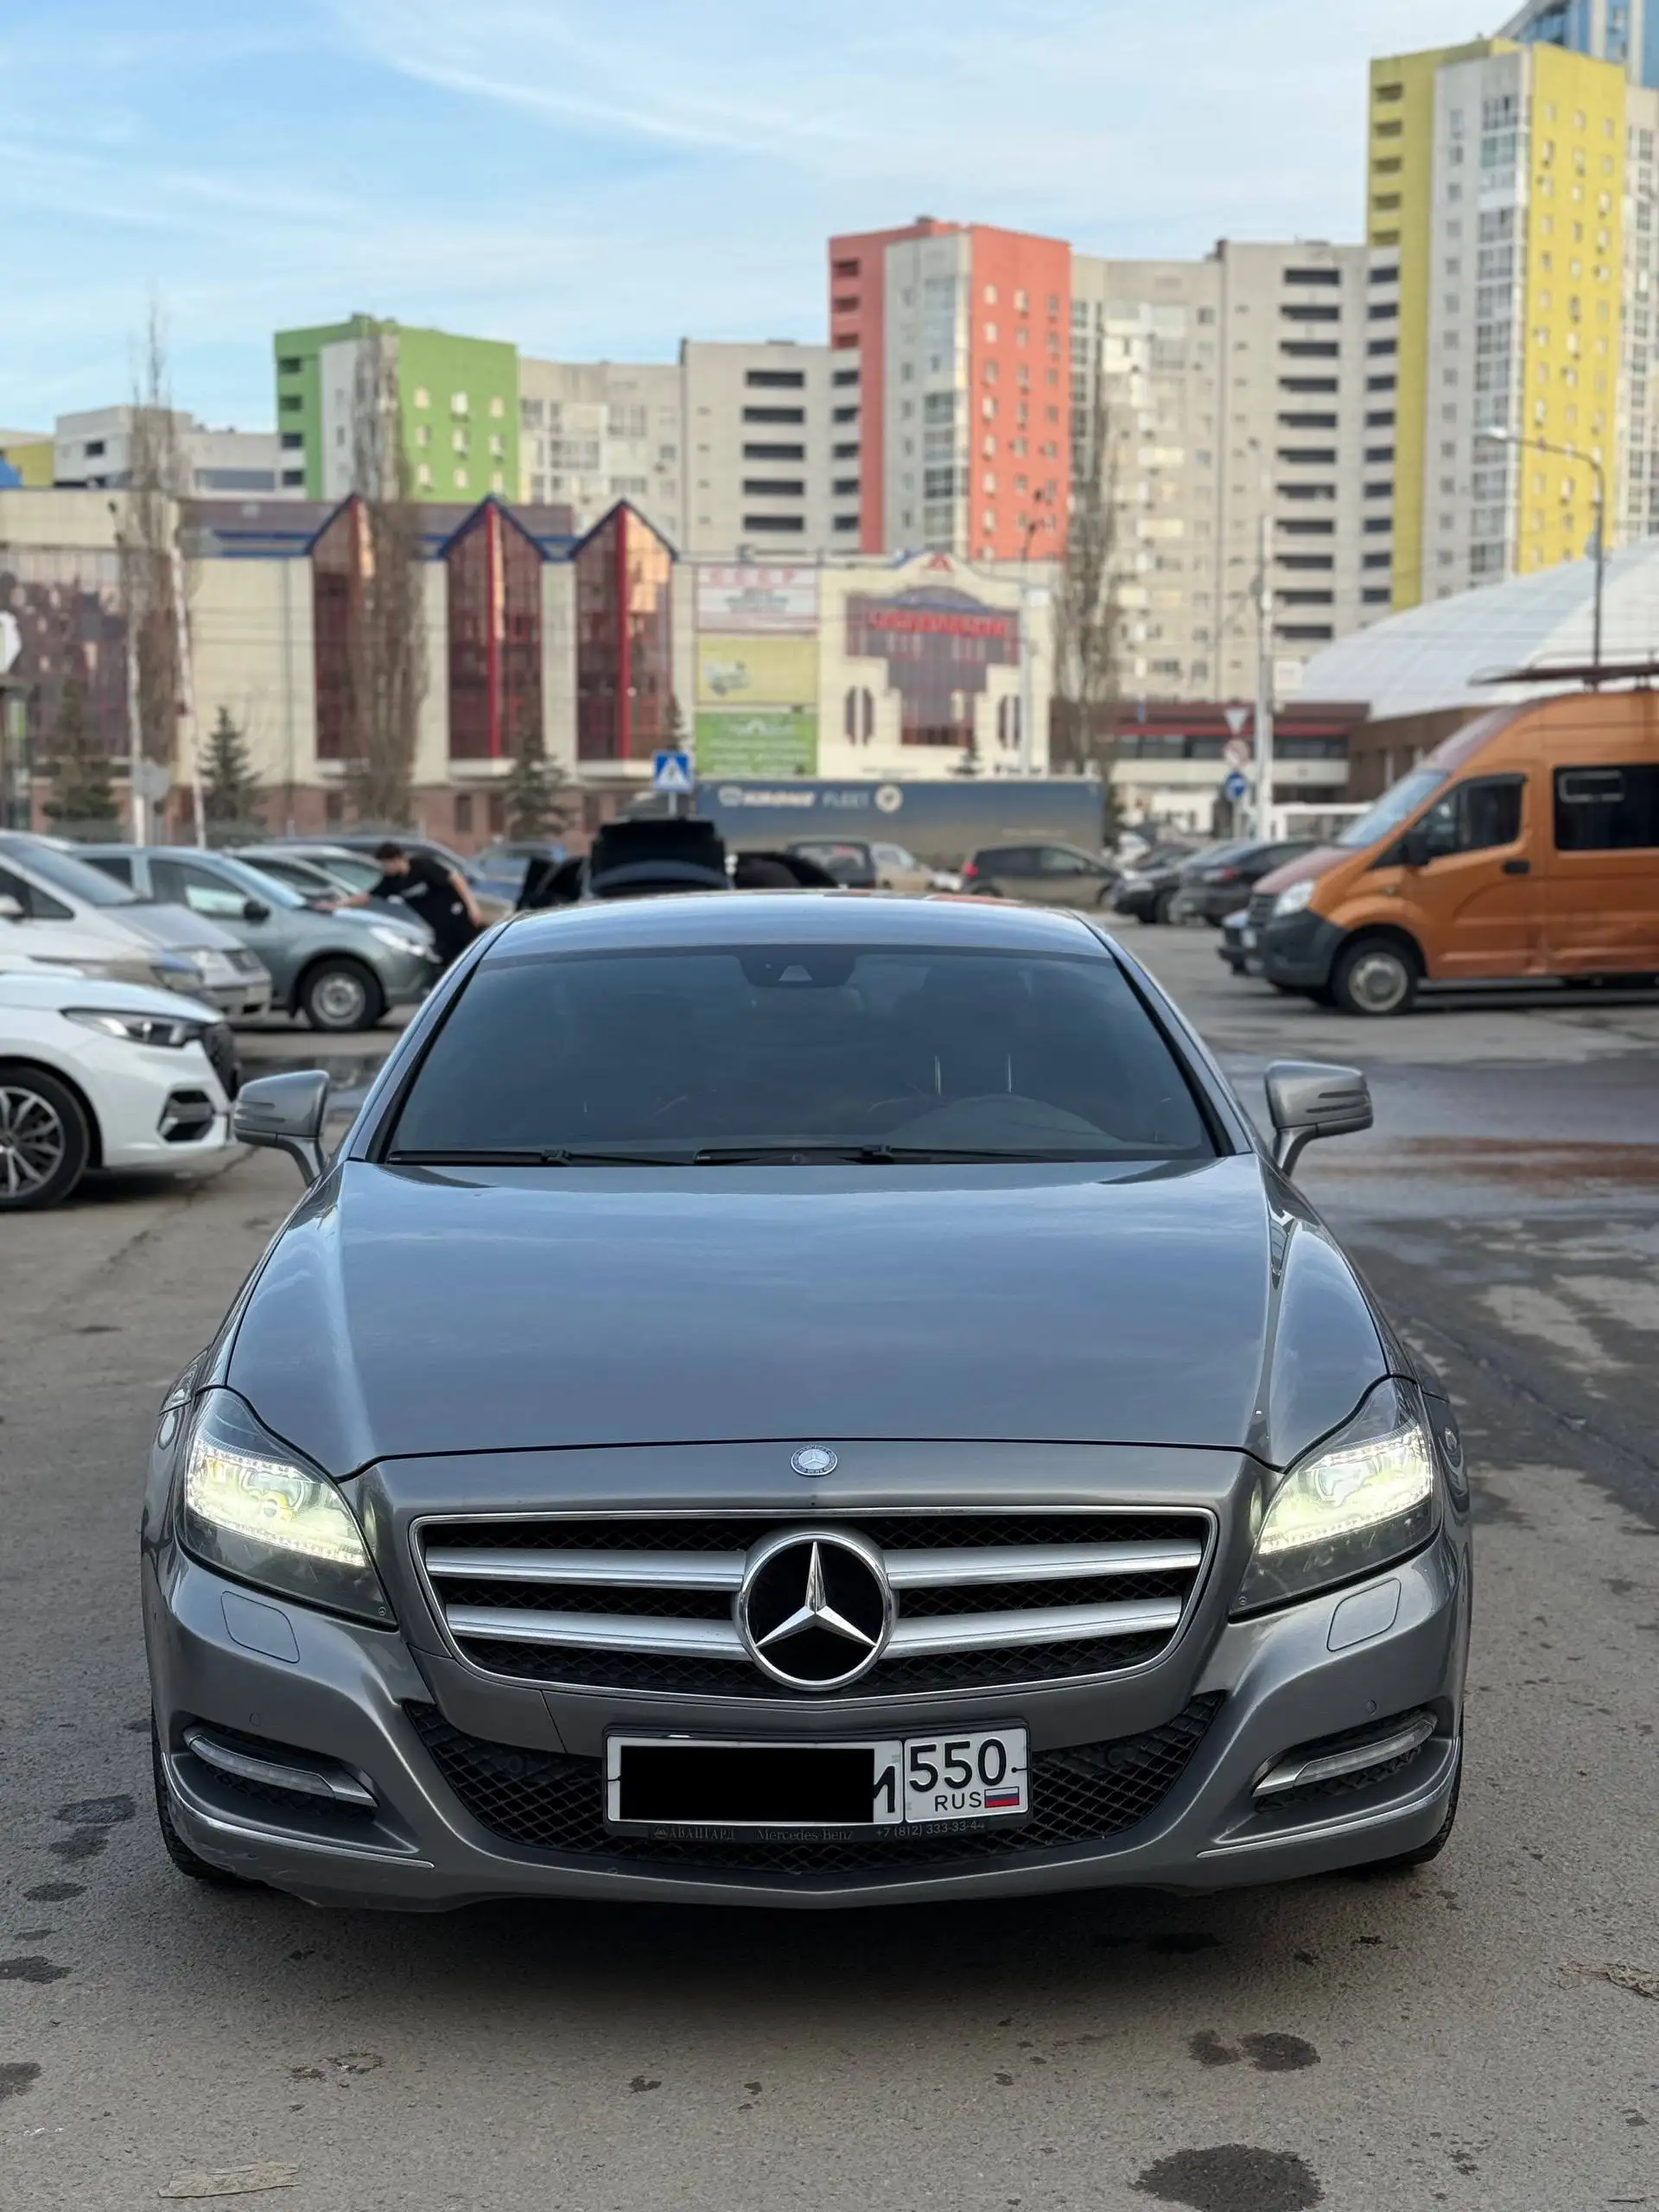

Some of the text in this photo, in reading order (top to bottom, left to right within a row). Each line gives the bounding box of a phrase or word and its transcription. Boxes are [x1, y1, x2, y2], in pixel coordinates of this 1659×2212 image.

[909, 1738, 1007, 1792] 550
[934, 1791, 982, 1812] RUS
[756, 1827, 854, 1841] Mercedes-Benz
[876, 1820, 985, 1838] +7 (812) 333-33-44
